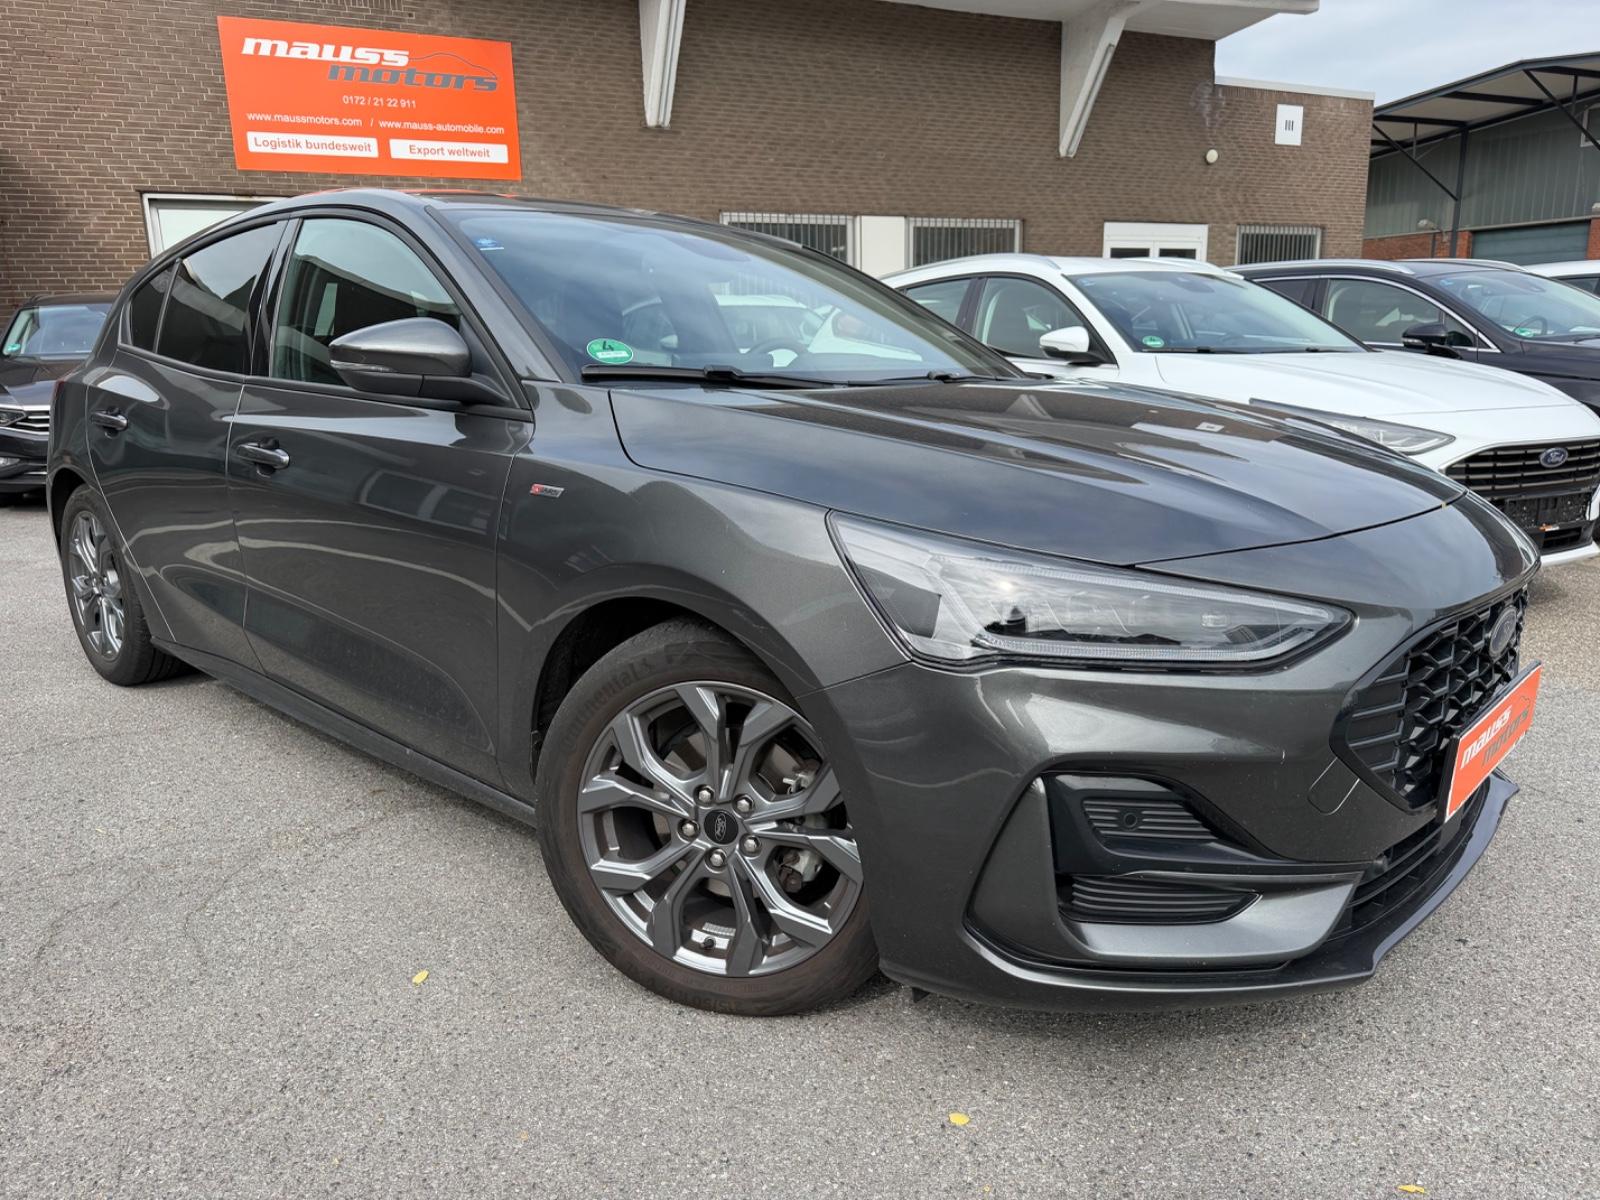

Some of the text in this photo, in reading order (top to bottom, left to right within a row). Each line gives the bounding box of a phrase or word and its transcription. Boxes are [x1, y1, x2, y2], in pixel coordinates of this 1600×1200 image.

[242, 37, 409, 66] mauss
[328, 63, 498, 91] motors
[342, 95, 366, 105] 0172
[373, 97, 384, 107] 21
[387, 98, 398, 108] 22
[400, 99, 416, 109] 911
[246, 112, 363, 126] www.maussmotors.com
[379, 120, 505, 134] www.mauss-automobile.com
[254, 137, 372, 152] Logistik bundesweit
[409, 144, 490, 158] Export weltweit
[1461, 707, 1512, 768] mauss
